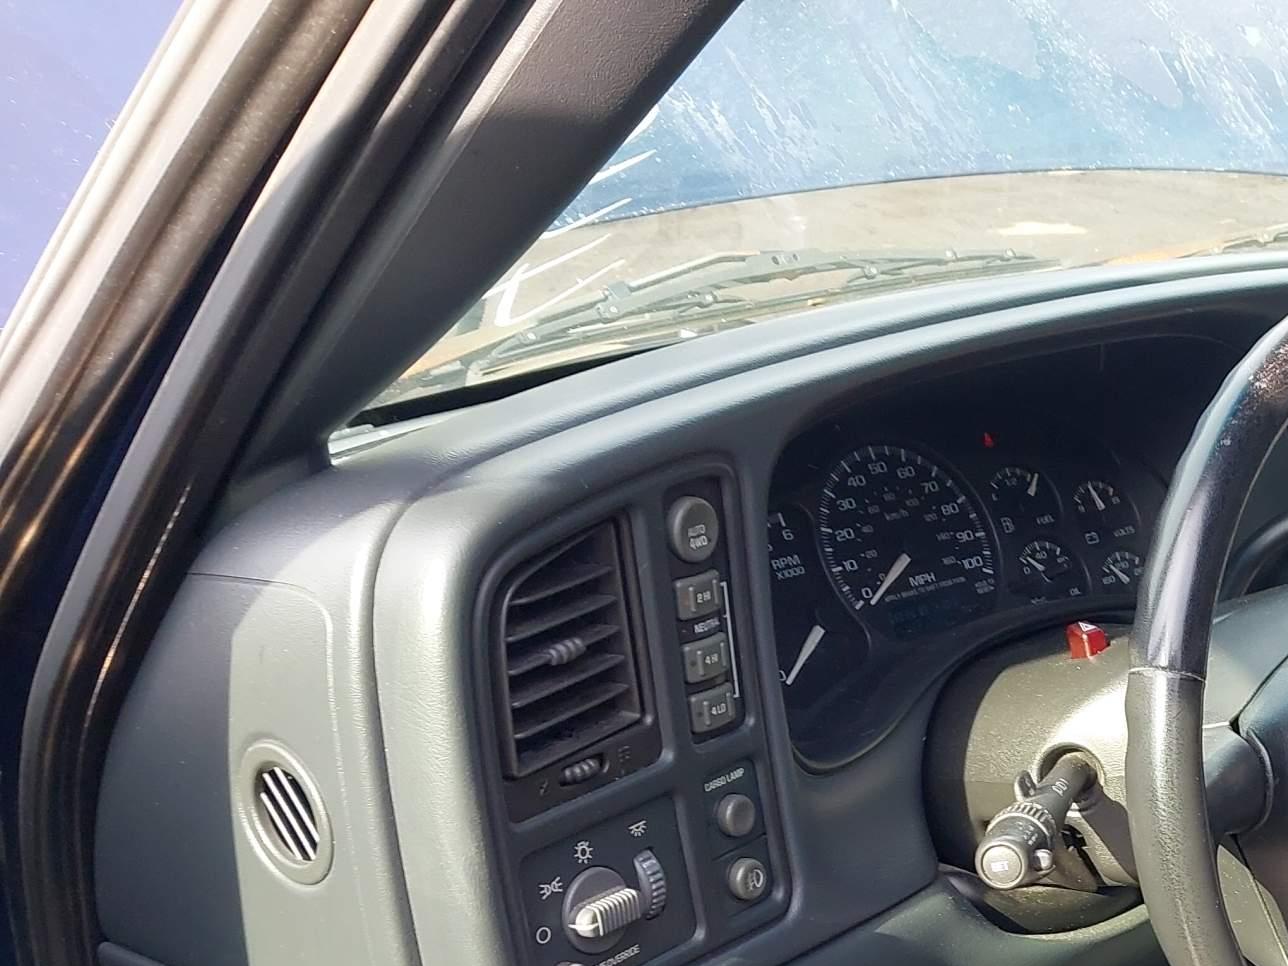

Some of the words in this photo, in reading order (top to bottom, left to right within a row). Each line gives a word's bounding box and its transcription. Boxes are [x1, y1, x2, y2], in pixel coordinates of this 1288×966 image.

[867, 461, 888, 475] 50
[896, 465, 916, 479] 60
[847, 474, 867, 487] 40
[920, 480, 939, 494] 70
[836, 497, 857, 511] 30
[940, 502, 960, 516] 80
[782, 529, 794, 541] 6
[834, 526, 856, 542] 20
[955, 529, 975, 543] 90
[771, 554, 800, 570] RPM
[841, 558, 859, 573] 10
[961, 555, 984, 571] 100
[908, 571, 937, 588] MPH
[861, 586, 873, 599] 0
